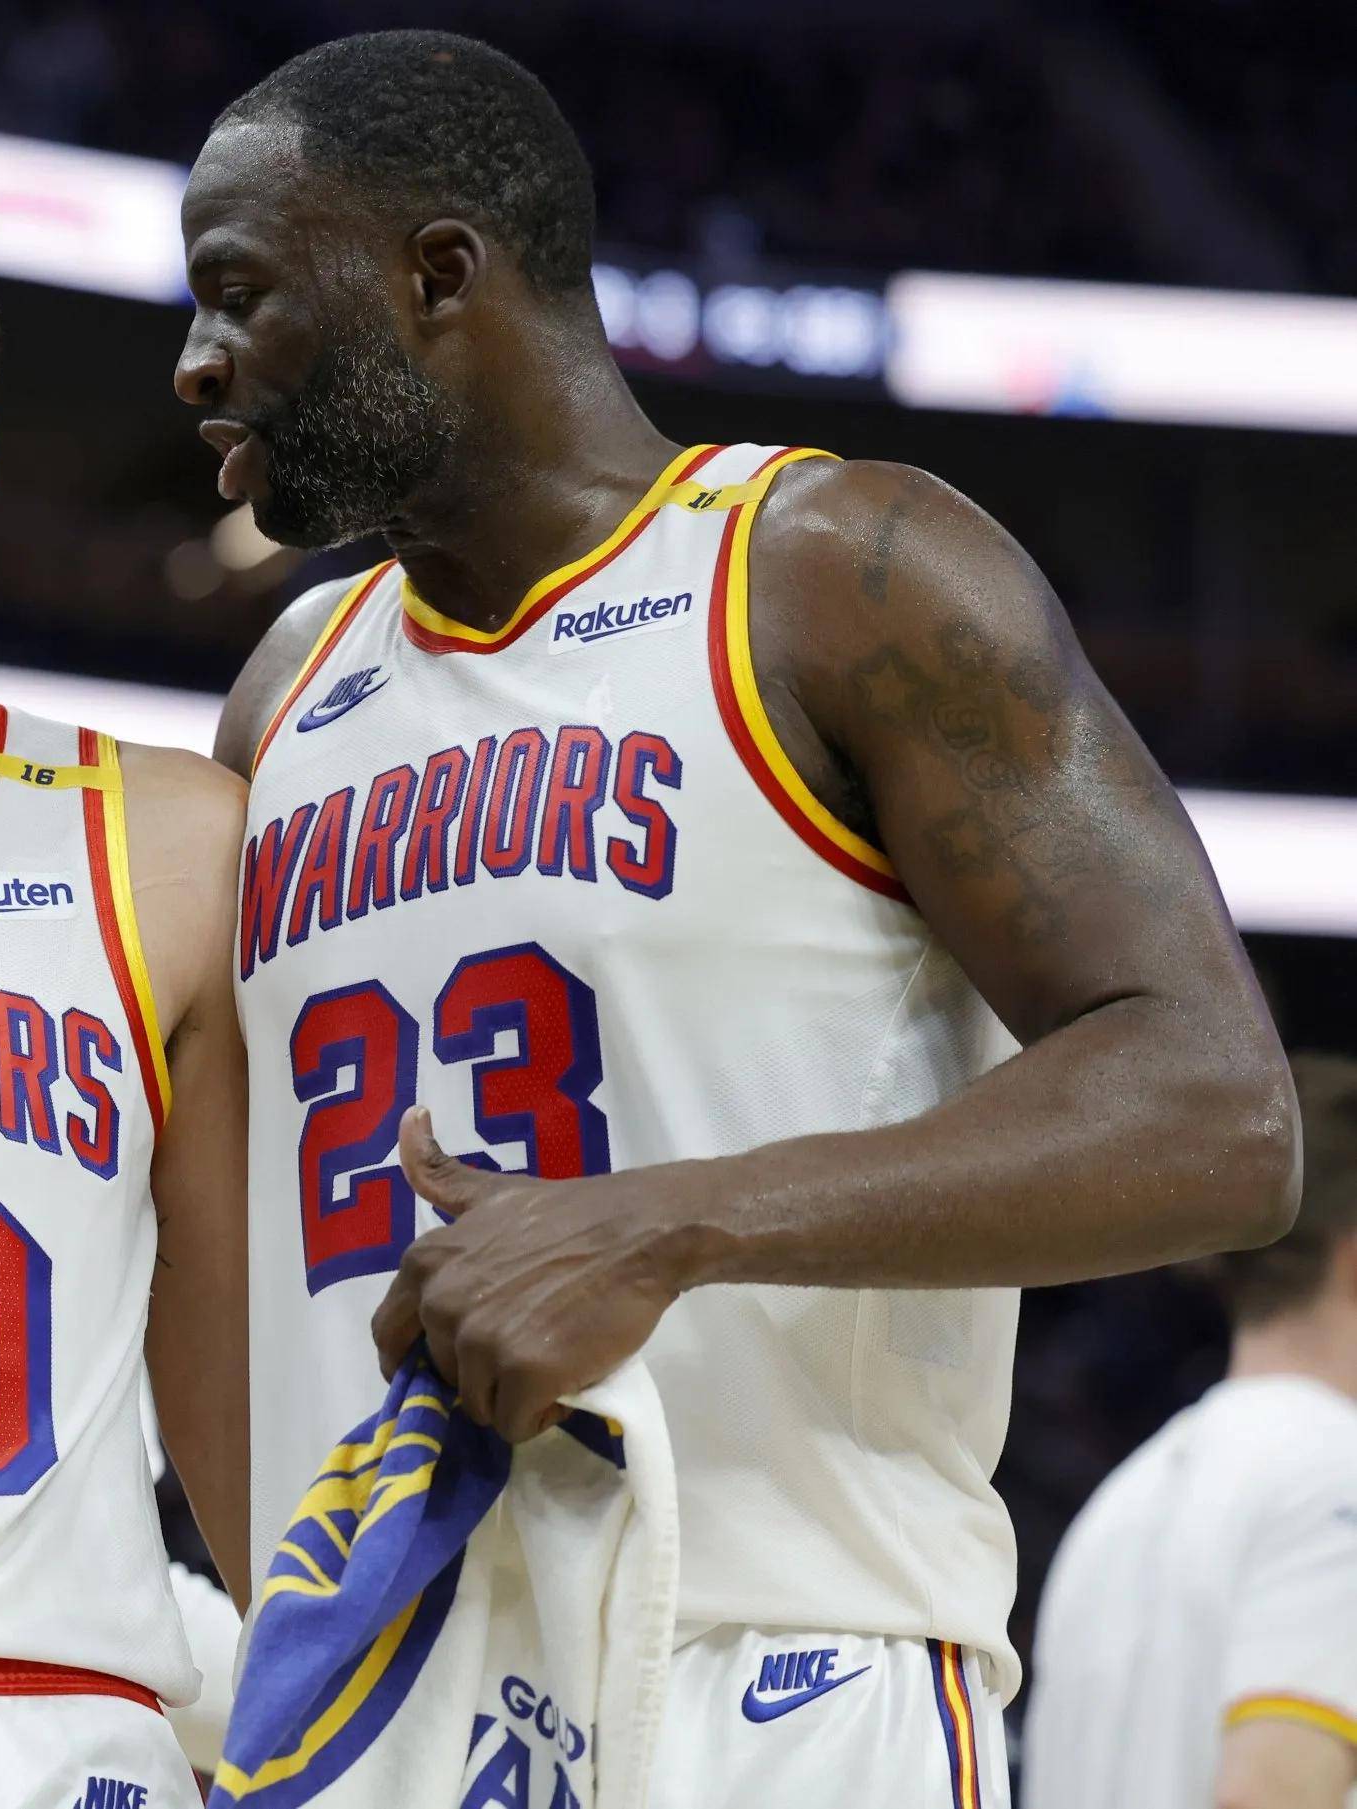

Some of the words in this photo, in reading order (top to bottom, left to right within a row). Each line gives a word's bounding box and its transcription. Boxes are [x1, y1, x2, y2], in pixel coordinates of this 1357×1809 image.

[687, 489, 723, 509] 16
[554, 592, 692, 642] Rakuten
[317, 665, 382, 709] NIKE
[20, 763, 56, 786] 16
[240, 725, 683, 982] WARRIORS
[289, 941, 611, 1298] 23
[756, 1648, 839, 1690] NIKE
[84, 1776, 148, 1809] NIKE
